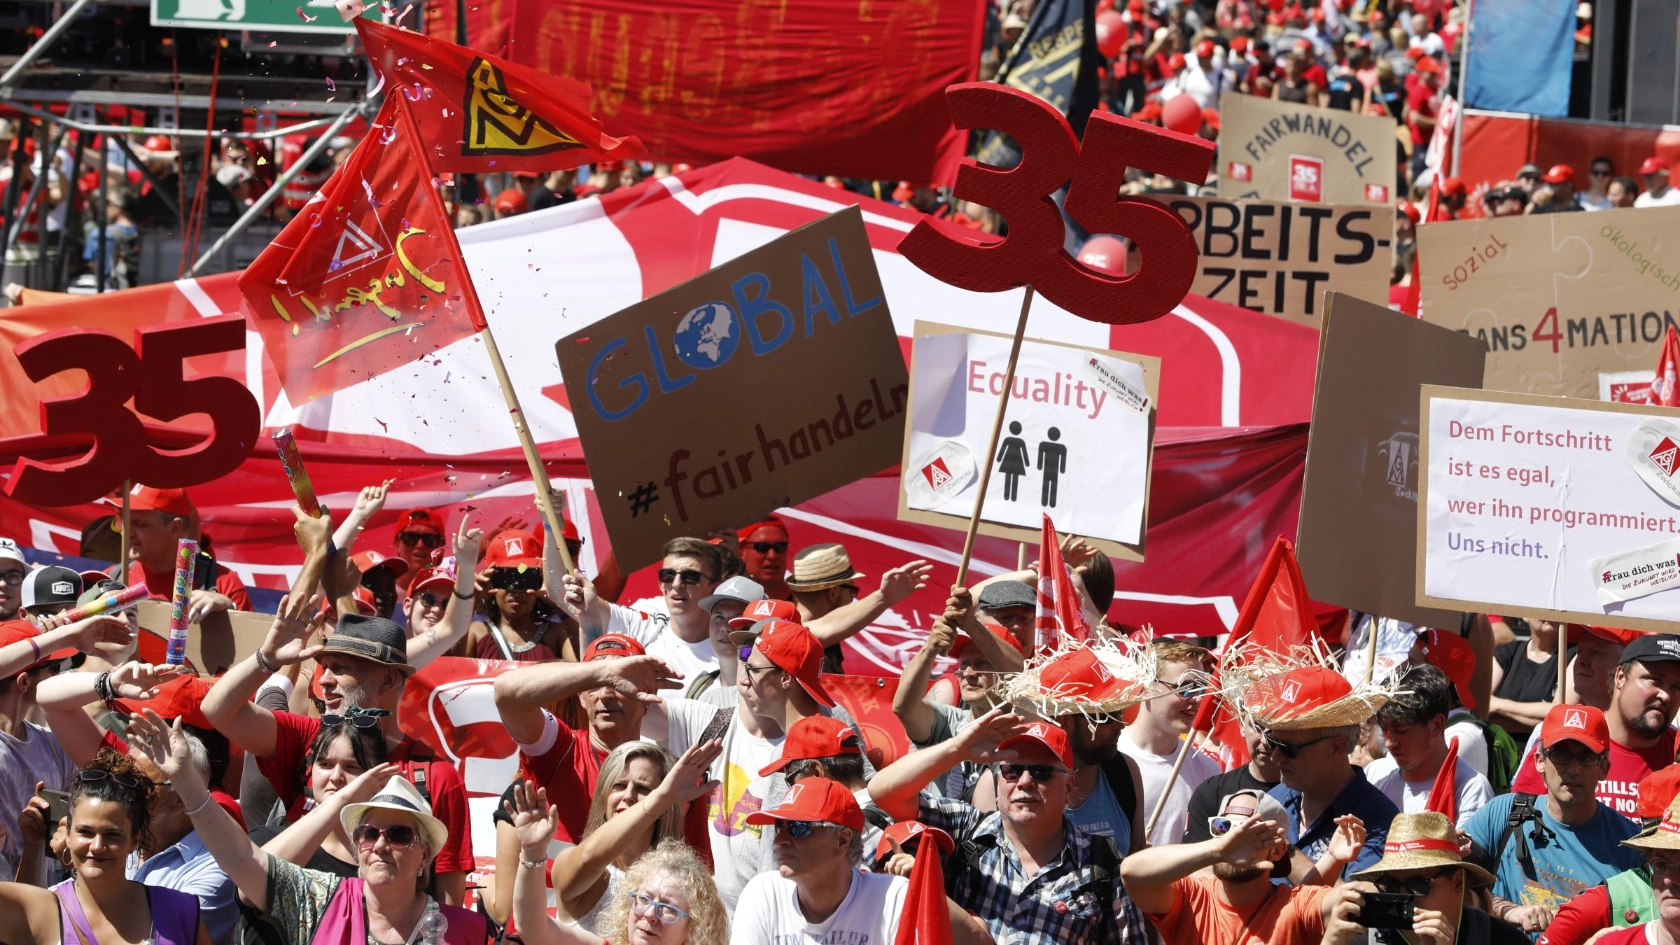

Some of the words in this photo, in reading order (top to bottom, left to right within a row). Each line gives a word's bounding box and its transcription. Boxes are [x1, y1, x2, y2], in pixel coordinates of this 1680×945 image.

[1245, 113, 1374, 178] FAIRWANDEL
[1293, 164, 1318, 183] 35
[896, 81, 1217, 326] 35
[1168, 199, 1391, 264] RBEITS-
[1203, 267, 1330, 315] ZEIT
[586, 238, 882, 422] GLOBAL
[968, 360, 1108, 420] Equality
[1110, 375, 1126, 391] dich
[3, 311, 262, 508] 35
[1449, 420, 1495, 441] Dem
[1501, 424, 1612, 451] Fortschritt
[1448, 457, 1473, 477] ist
[1479, 465, 1501, 480] es
[1506, 465, 1555, 488] egal,
[1655, 470, 1680, 498] Zwicka
[1448, 499, 1486, 515] wer
[1492, 498, 1523, 519] ihn
[1529, 506, 1680, 534] programmiert.
[1448, 532, 1485, 553] Uns
[1492, 536, 1549, 560] nicht.
[1632, 564, 1654, 576] dich
